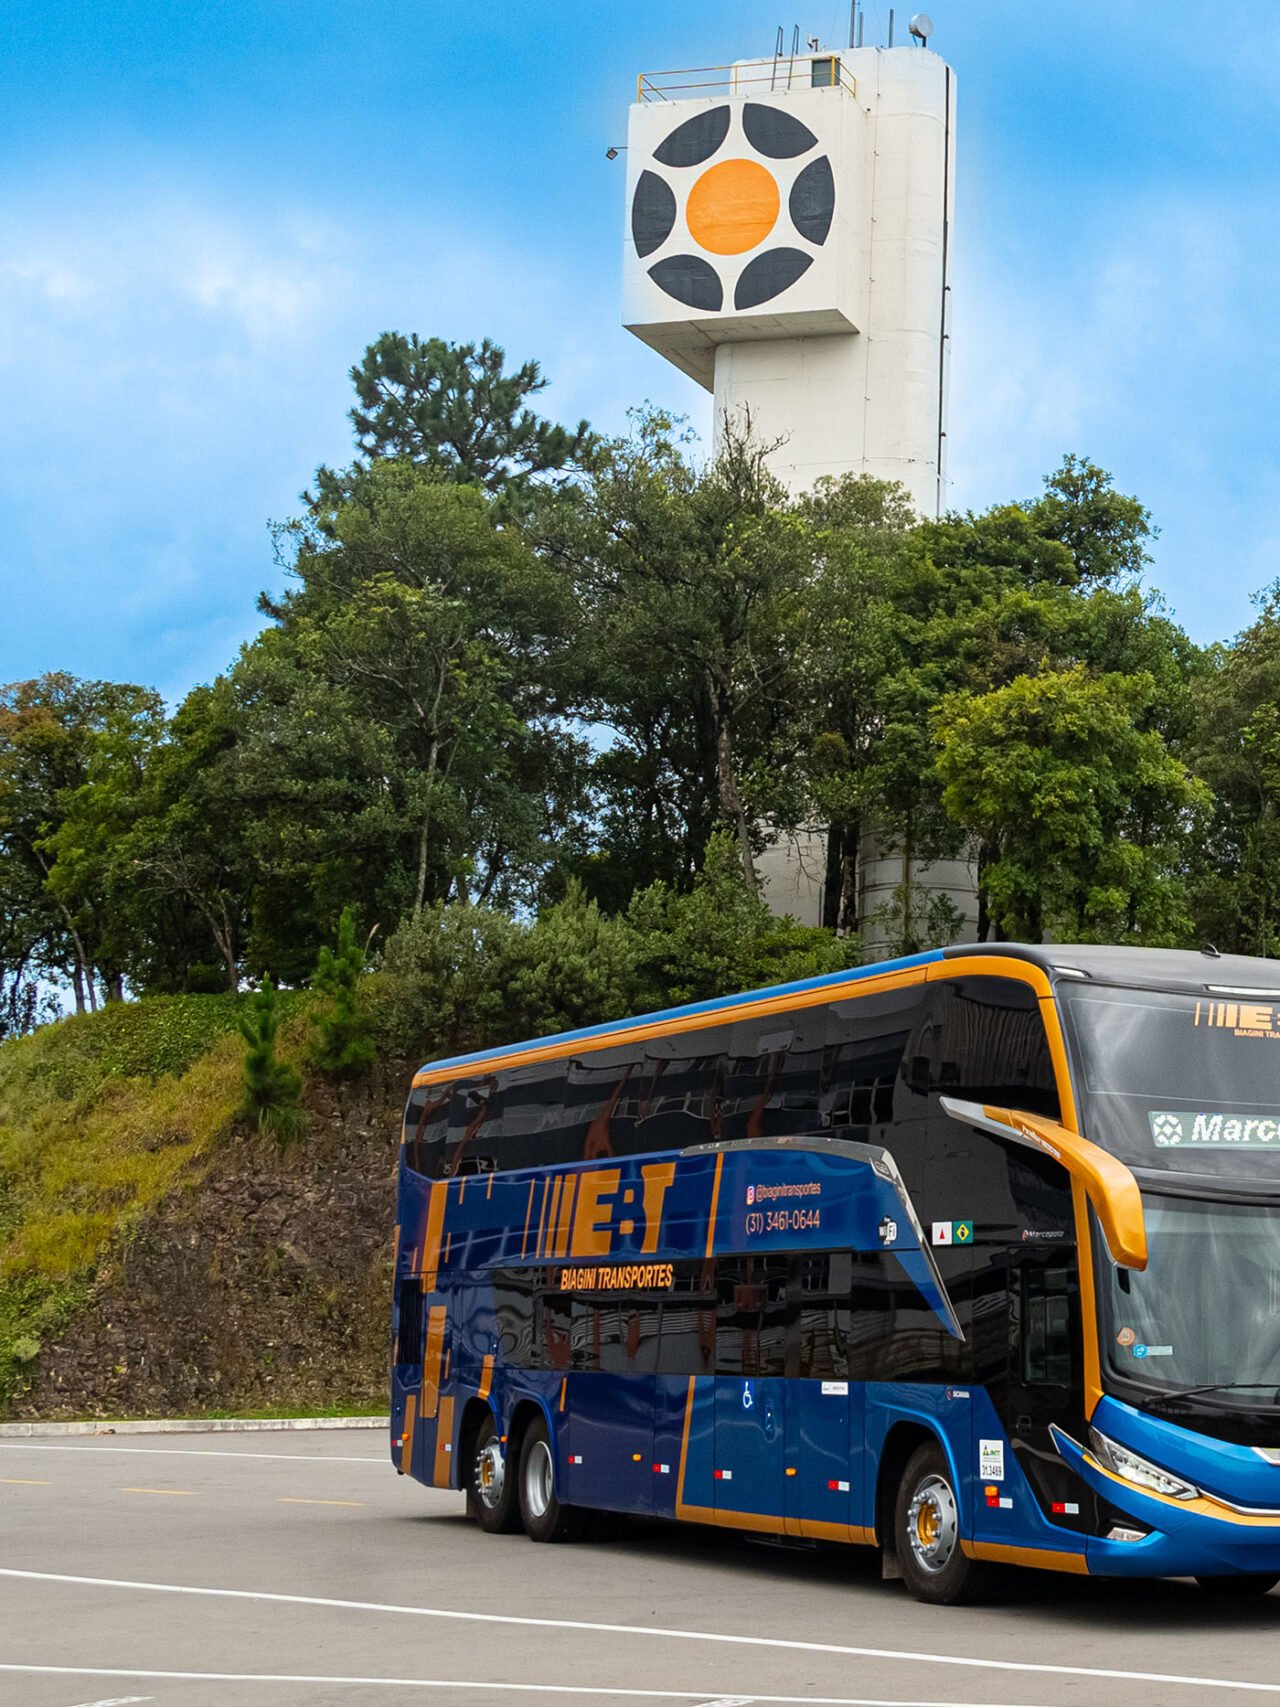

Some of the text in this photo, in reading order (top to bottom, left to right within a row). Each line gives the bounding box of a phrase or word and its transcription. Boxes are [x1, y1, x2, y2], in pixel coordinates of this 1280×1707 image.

[745, 1209, 820, 1235] (31) 3461-0644
[560, 1264, 674, 1290] BIAGINI TRANSPORTES
